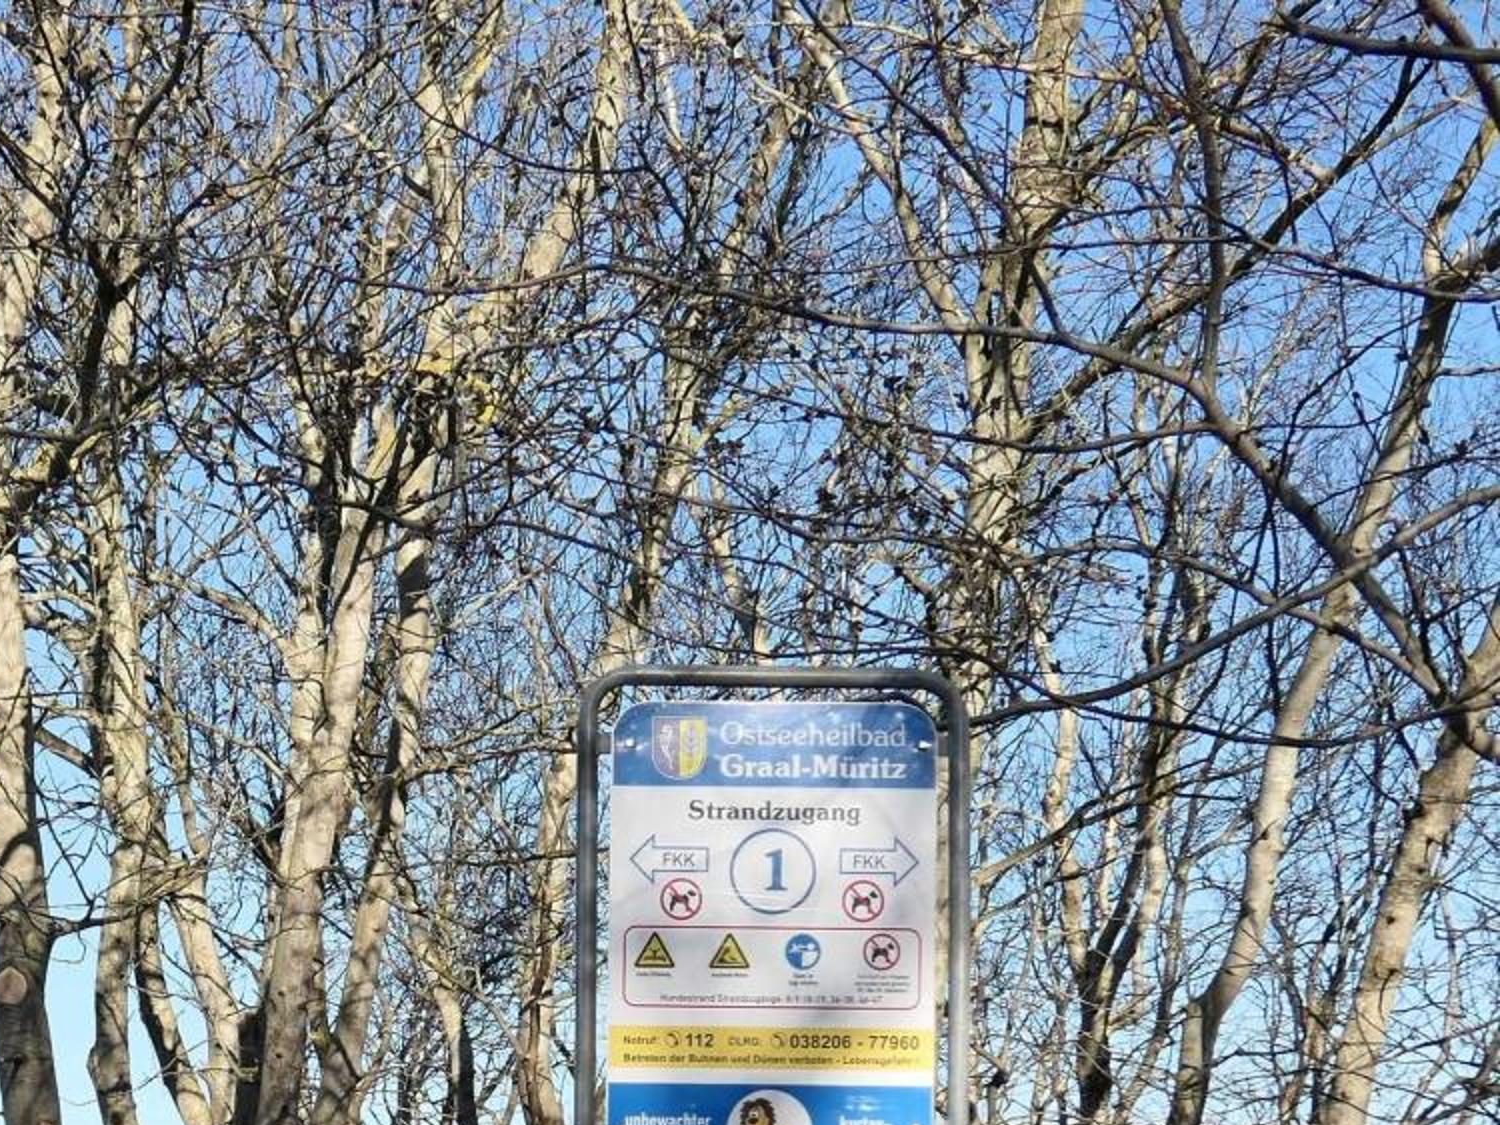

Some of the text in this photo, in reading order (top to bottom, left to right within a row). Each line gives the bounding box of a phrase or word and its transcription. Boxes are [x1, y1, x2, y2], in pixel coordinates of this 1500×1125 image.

[719, 720, 906, 748] Ostseeheilbad
[719, 752, 908, 779] Graal-Müritz
[687, 799, 862, 825] Strandzugang
[662, 851, 696, 867] FKK
[763, 847, 789, 891] 1
[851, 853, 886, 869] FKK
[685, 1032, 715, 1048] 112
[789, 1034, 852, 1049] 038206
[867, 1035, 920, 1051] 77960
[622, 1053, 667, 1063] Betreten
[669, 1053, 687, 1063] der
[688, 1053, 729, 1064] Buhnen
[731, 1054, 751, 1064] und
[753, 1053, 787, 1065] Dünen
[788, 1055, 834, 1065] verboten
